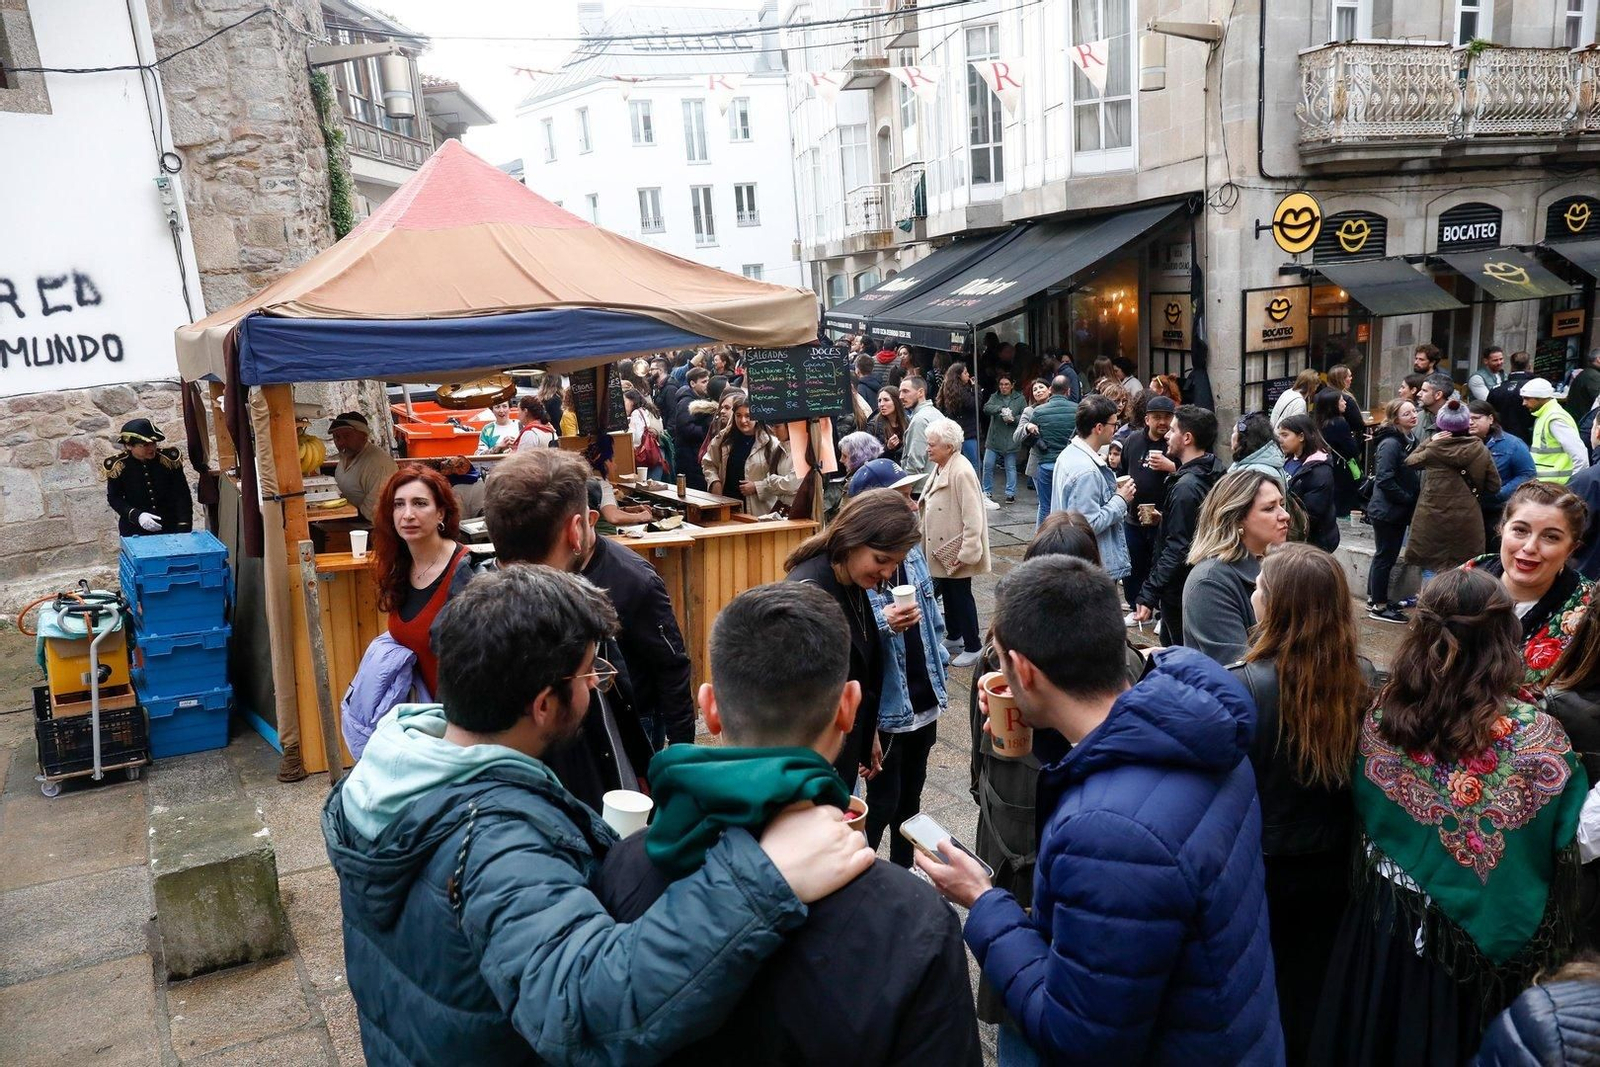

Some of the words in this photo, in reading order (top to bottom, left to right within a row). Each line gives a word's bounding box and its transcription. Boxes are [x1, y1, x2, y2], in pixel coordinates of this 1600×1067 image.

[1077, 43, 1105, 68] R
[904, 67, 934, 87] R
[991, 62, 1021, 91] R
[1443, 222, 1497, 242] BOCATEO
[1262, 326, 1293, 337] BOCATEO
[0, 333, 123, 368] MUNDO
[747, 350, 788, 361] SALGADAS
[810, 347, 841, 356] DOCES
[1005, 707, 1027, 731] R
